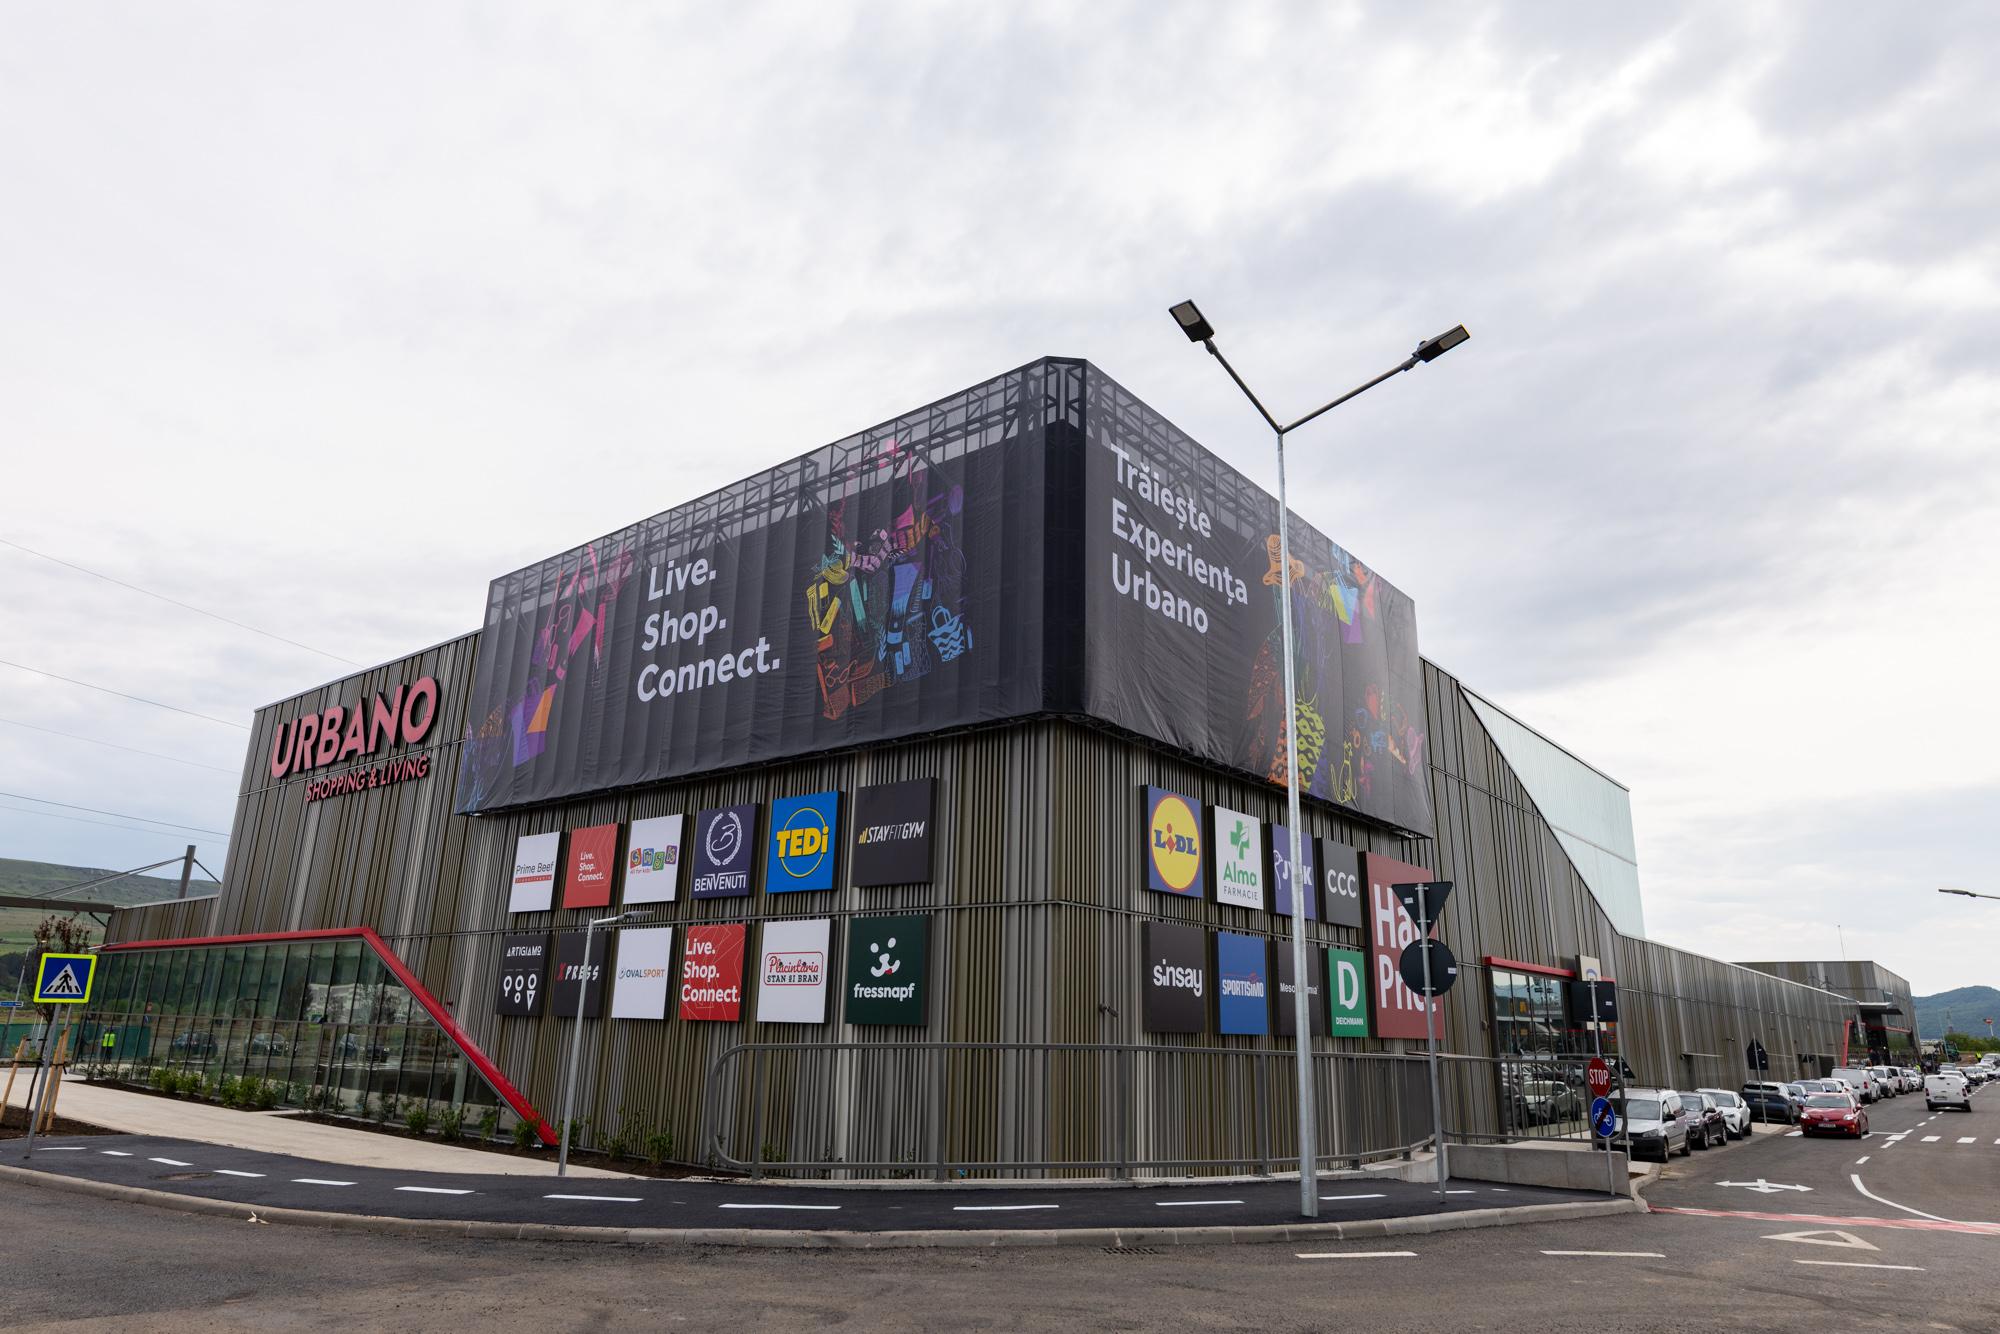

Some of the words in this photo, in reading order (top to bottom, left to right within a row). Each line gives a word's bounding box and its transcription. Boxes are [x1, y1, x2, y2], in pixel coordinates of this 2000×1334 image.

[1111, 443, 1212, 538] Trăiește
[1112, 497, 1249, 605] Experiența
[648, 558, 717, 601] Live.
[1112, 552, 1209, 634] Urbano
[641, 605, 727, 651] Shop.
[637, 636, 781, 702] Connect.
[271, 675, 438, 779] URBANO
[305, 769, 367, 802] SHOPPING
[368, 768, 377, 788] &
[380, 755, 429, 785] LIVING
[516, 864, 536, 875] Prime
[537, 861, 554, 873] Beef
[579, 862, 596, 872] Shop.
[580, 852, 594, 861] Live.
[694, 871, 747, 892] BENVENUTI
[1223, 860, 1257, 886] Alma
[1327, 869, 1357, 898] CCC
[1223, 886, 1258, 900] FARMACIE
[686, 938, 716, 956] Live.
[683, 961, 720, 983] Shop.
[767, 975, 786, 983] STAN
[798, 975, 819, 983] BRAN
[1153, 958, 1203, 997] sinsay
[1337, 960, 1359, 1010] D
[681, 984, 741, 1003] Connect.
[854, 983, 915, 1002] fressnapf
[1588, 1068, 1609, 1086] STOP
